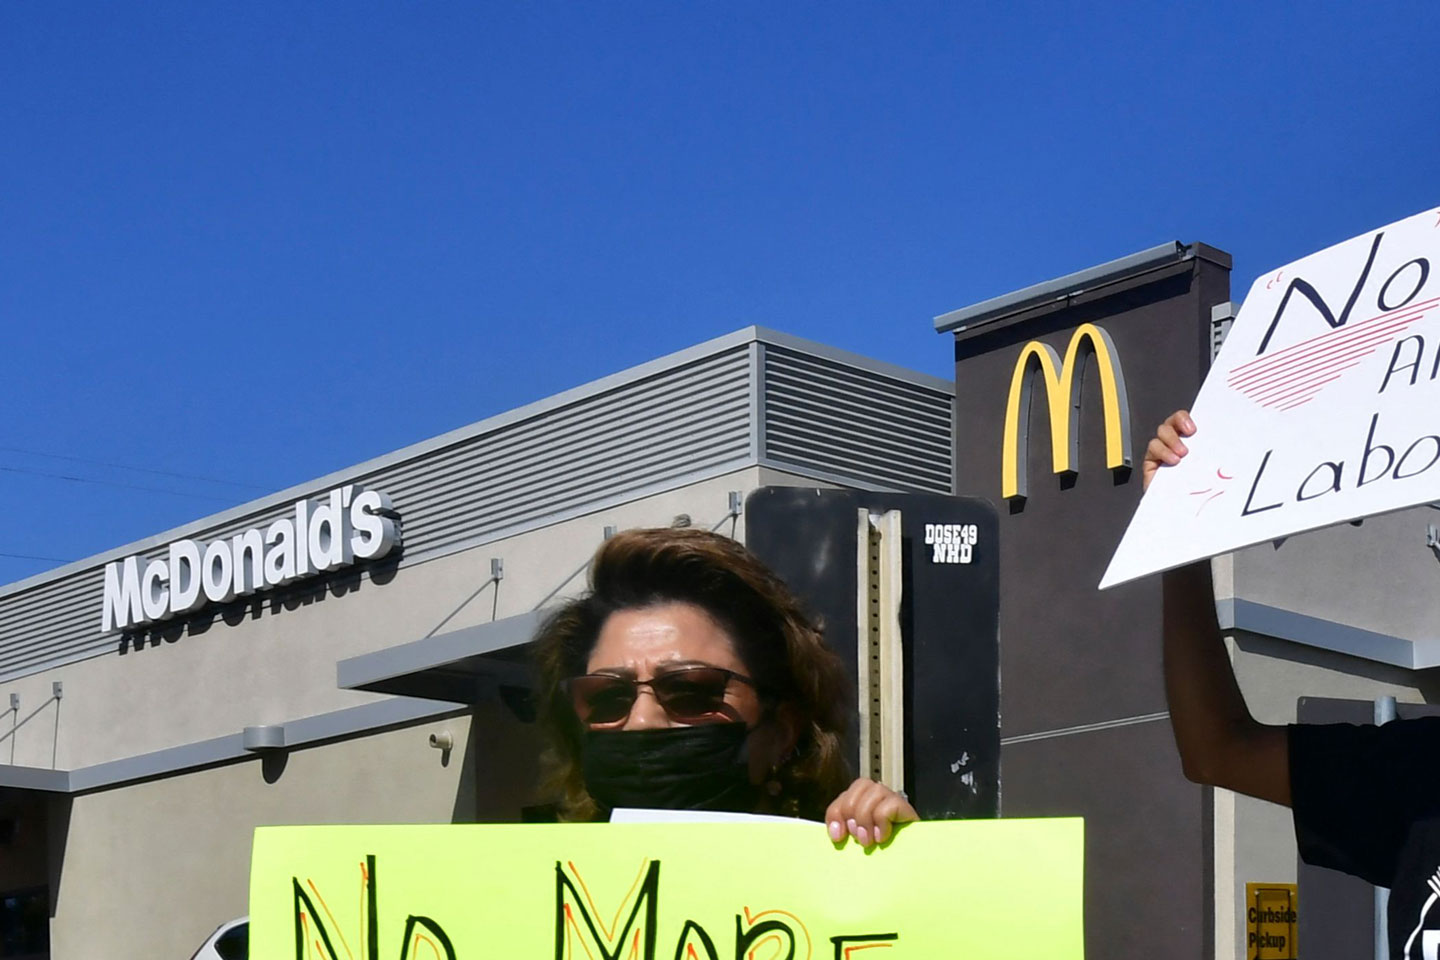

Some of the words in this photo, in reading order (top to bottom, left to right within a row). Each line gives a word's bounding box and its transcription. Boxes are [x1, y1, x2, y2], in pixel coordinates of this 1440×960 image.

[924, 523, 978, 545] DOSE49
[101, 484, 393, 633] McDonald's
[932, 543, 973, 565] NHD
[1248, 905, 1297, 925] Curbside
[1248, 931, 1287, 952] Pickup
